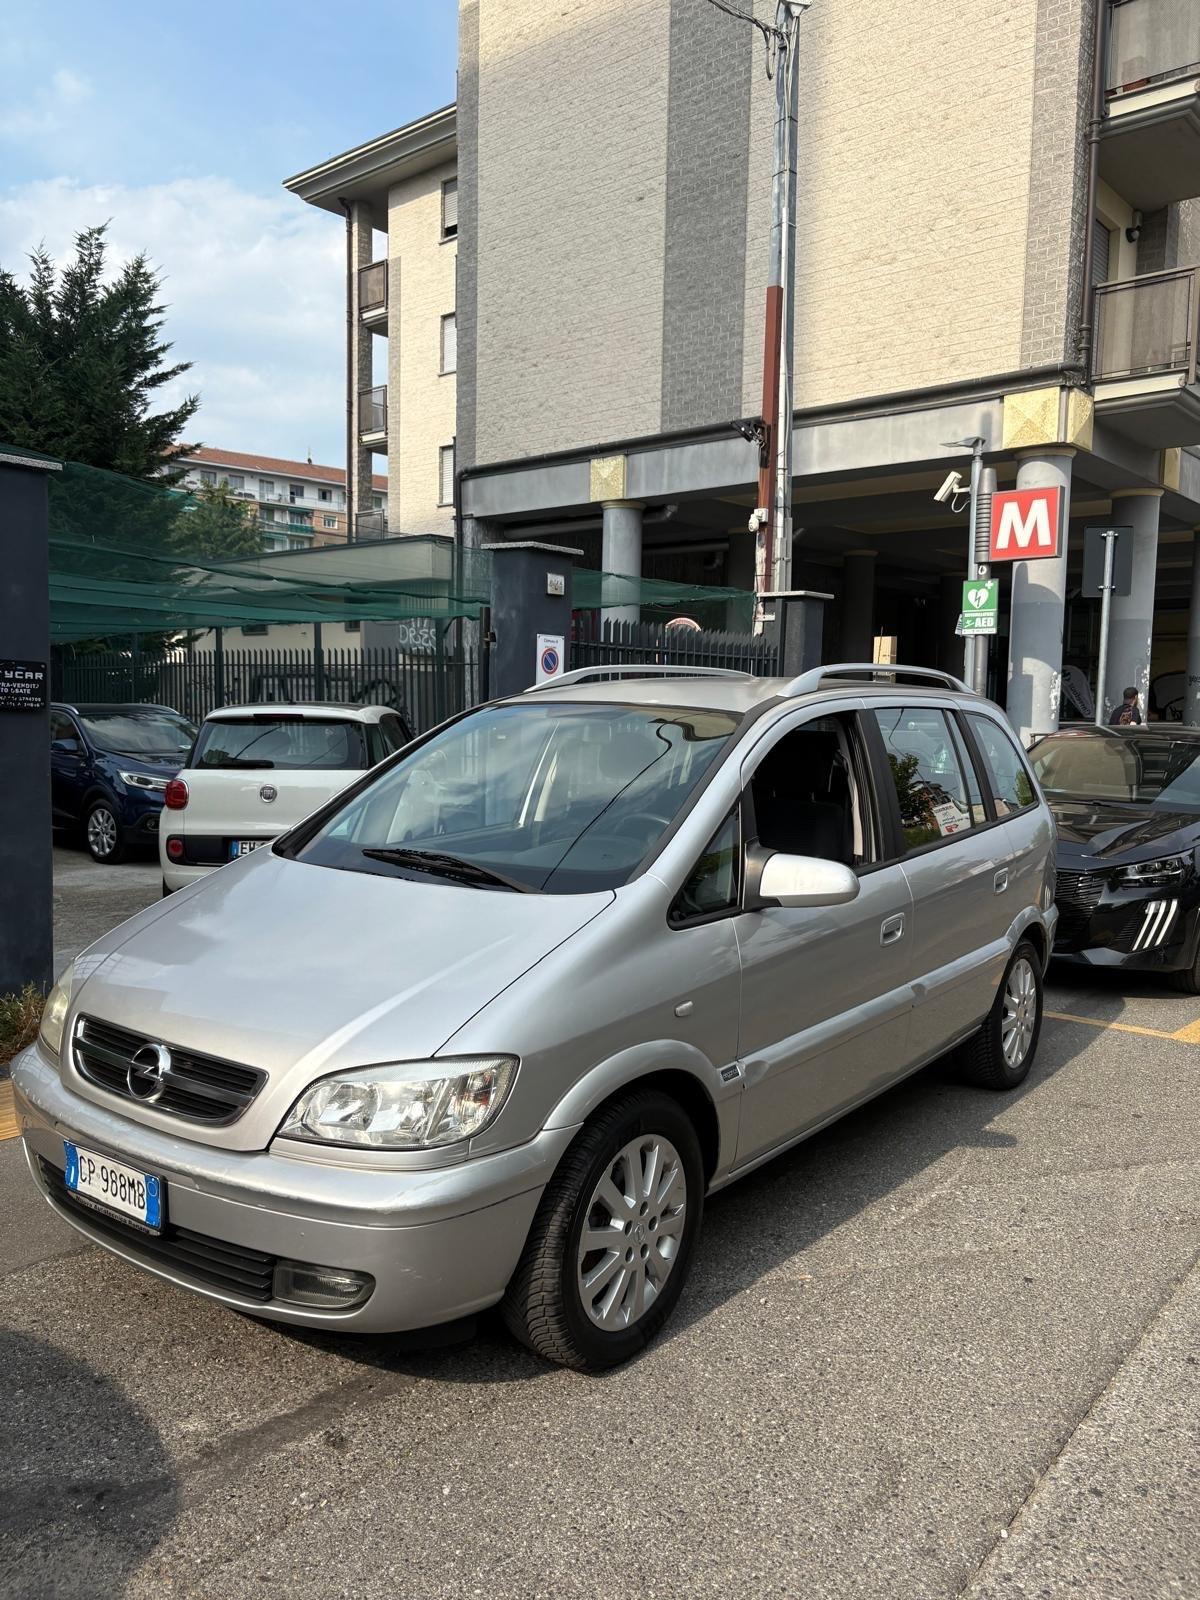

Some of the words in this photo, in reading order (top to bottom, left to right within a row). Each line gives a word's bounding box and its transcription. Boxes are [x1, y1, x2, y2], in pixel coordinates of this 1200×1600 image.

[996, 498, 1051, 549] M
[975, 617, 994, 628] AED
[0, 671, 43, 680] YCAR
[79, 1155, 96, 1186] CP
[101, 1165, 146, 1210] 988MB
